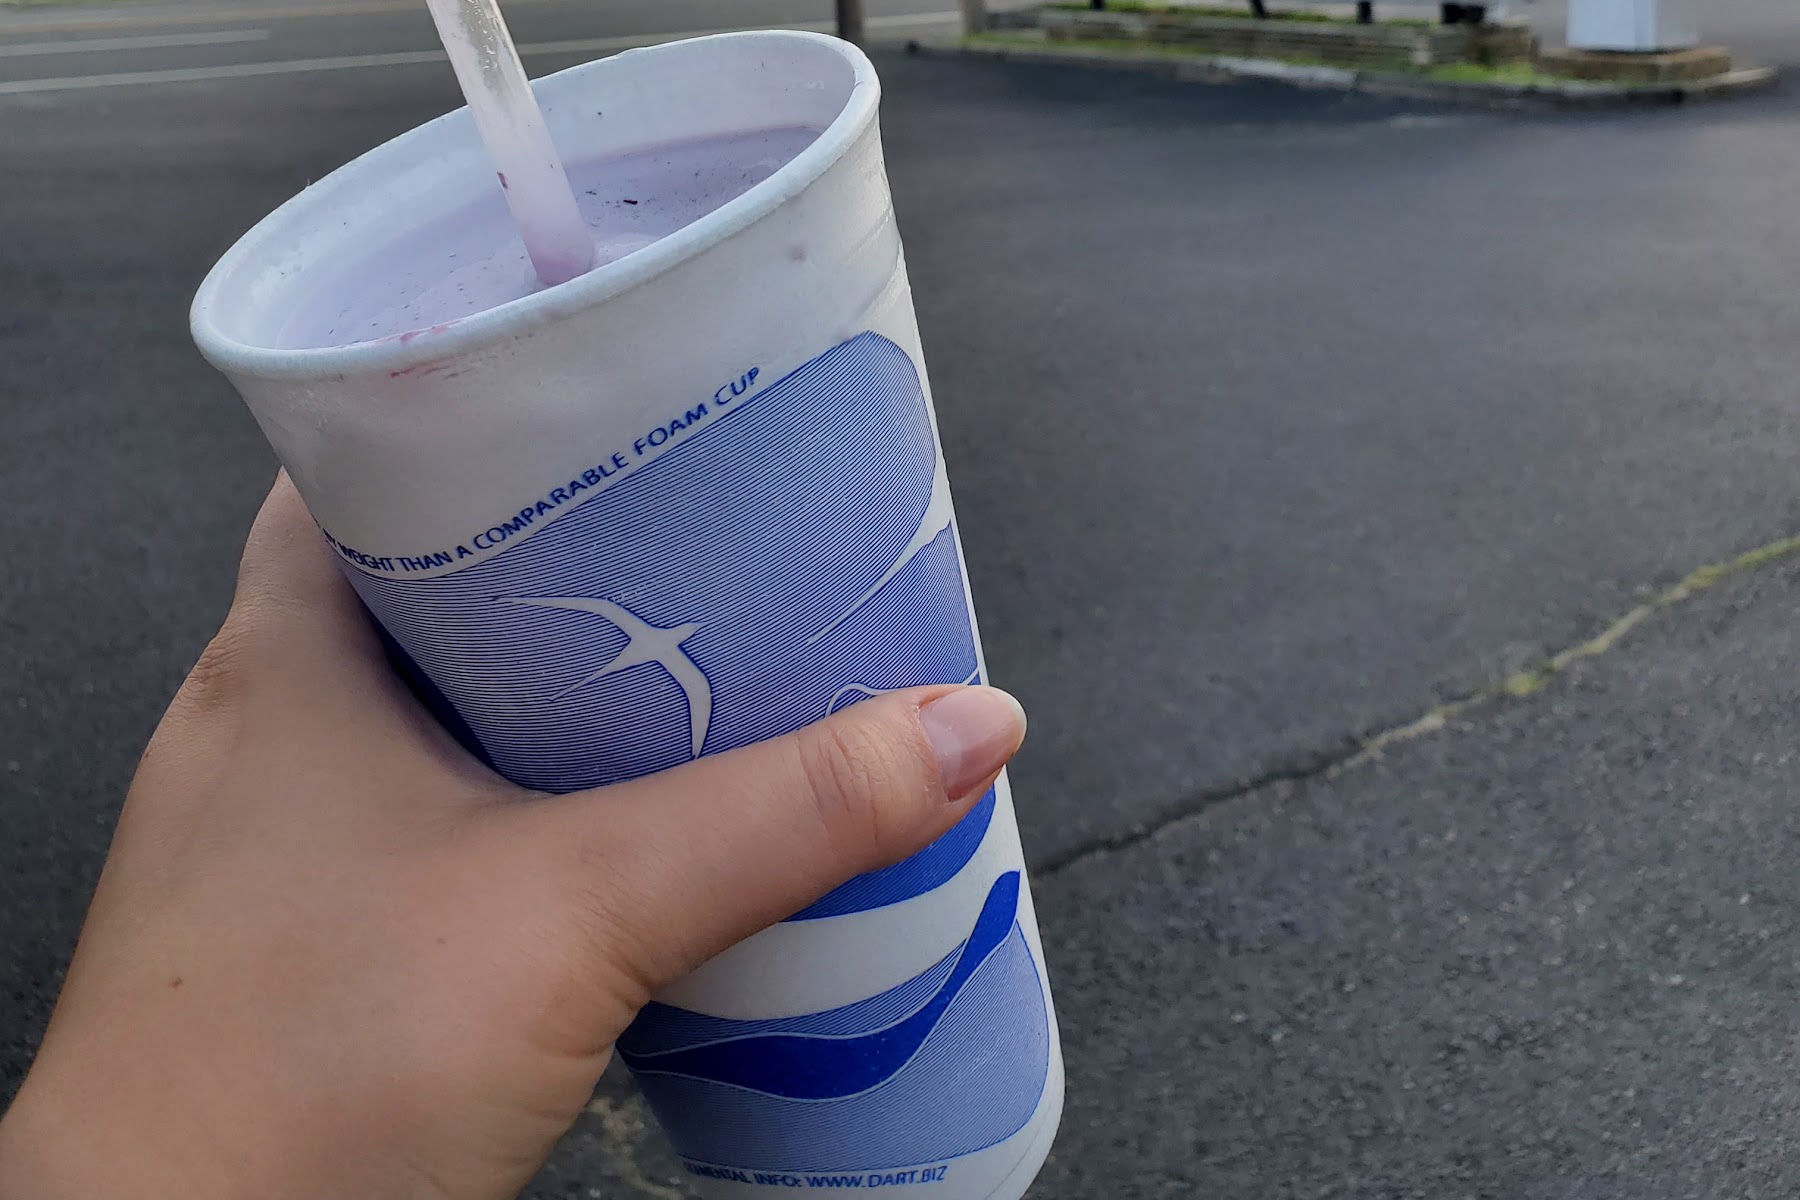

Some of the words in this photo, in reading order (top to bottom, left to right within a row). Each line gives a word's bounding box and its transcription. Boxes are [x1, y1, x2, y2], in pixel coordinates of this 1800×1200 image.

[337, 542, 396, 573] WEIGHT
[394, 550, 454, 574] THAN
[457, 545, 474, 560] A
[473, 452, 629, 551] COMPARABLE
[634, 402, 709, 456] FOAM
[714, 366, 761, 406] CUP
[805, 1165, 948, 1188] WWW.DART.BIZ
